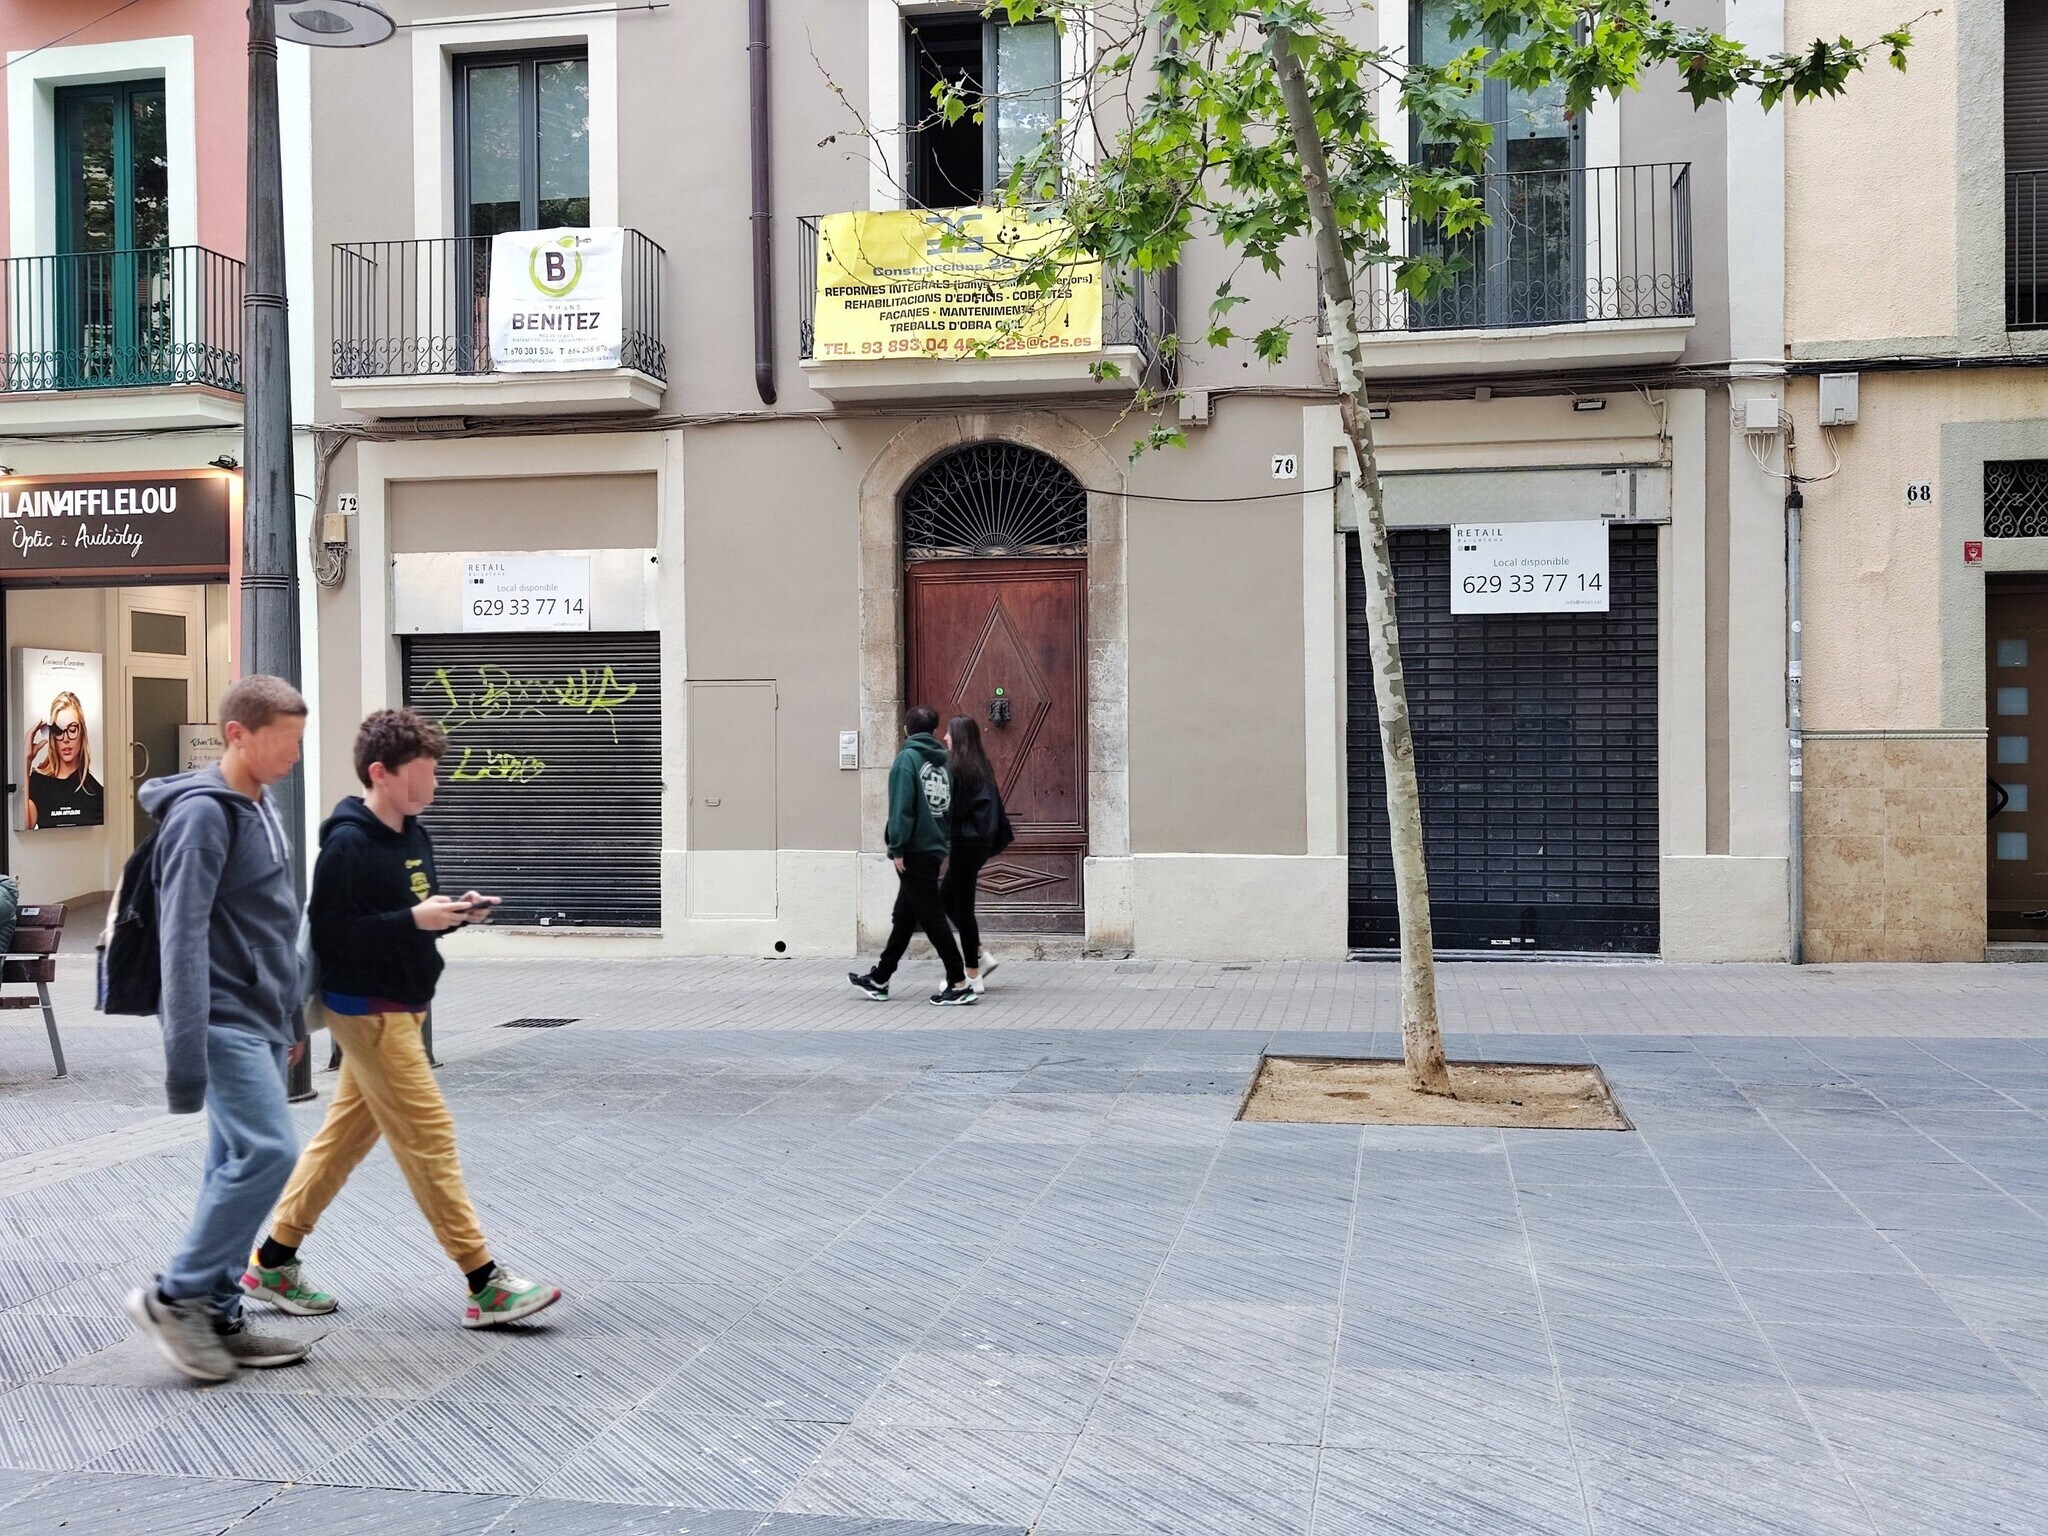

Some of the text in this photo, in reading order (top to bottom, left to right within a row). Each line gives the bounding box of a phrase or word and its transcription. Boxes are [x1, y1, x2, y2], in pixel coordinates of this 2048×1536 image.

[545, 252, 566, 281] B
[824, 285, 886, 297] REFORMES
[888, 280, 950, 295] INTEGRALS
[844, 293, 942, 310] REHABILITACIONS
[512, 312, 600, 331] BENITEZ
[889, 320, 946, 333] TREBALLS
[948, 319, 992, 331] D'OBRA
[511, 347, 523, 356] 670
[524, 347, 537, 355] 301
[823, 343, 856, 355] TEL.
[861, 341, 883, 354] 93
[888, 339, 920, 353] 893
[925, 337, 949, 352] 04
[1274, 458, 1294, 474] 70
[1907, 485, 1931, 501] 68
[340, 497, 357, 511] 72
[12, 520, 143, 558] Òptic i Audiòleg
[1457, 528, 1503, 537] RETAIL
[468, 563, 505, 572] RETAIL
[1493, 557, 1570, 568] Local disponible
[497, 583, 559, 593] Local disponible
[1462, 573, 1603, 594] 629 33 77 14
[473, 598, 584, 616] 629 33 77 14
